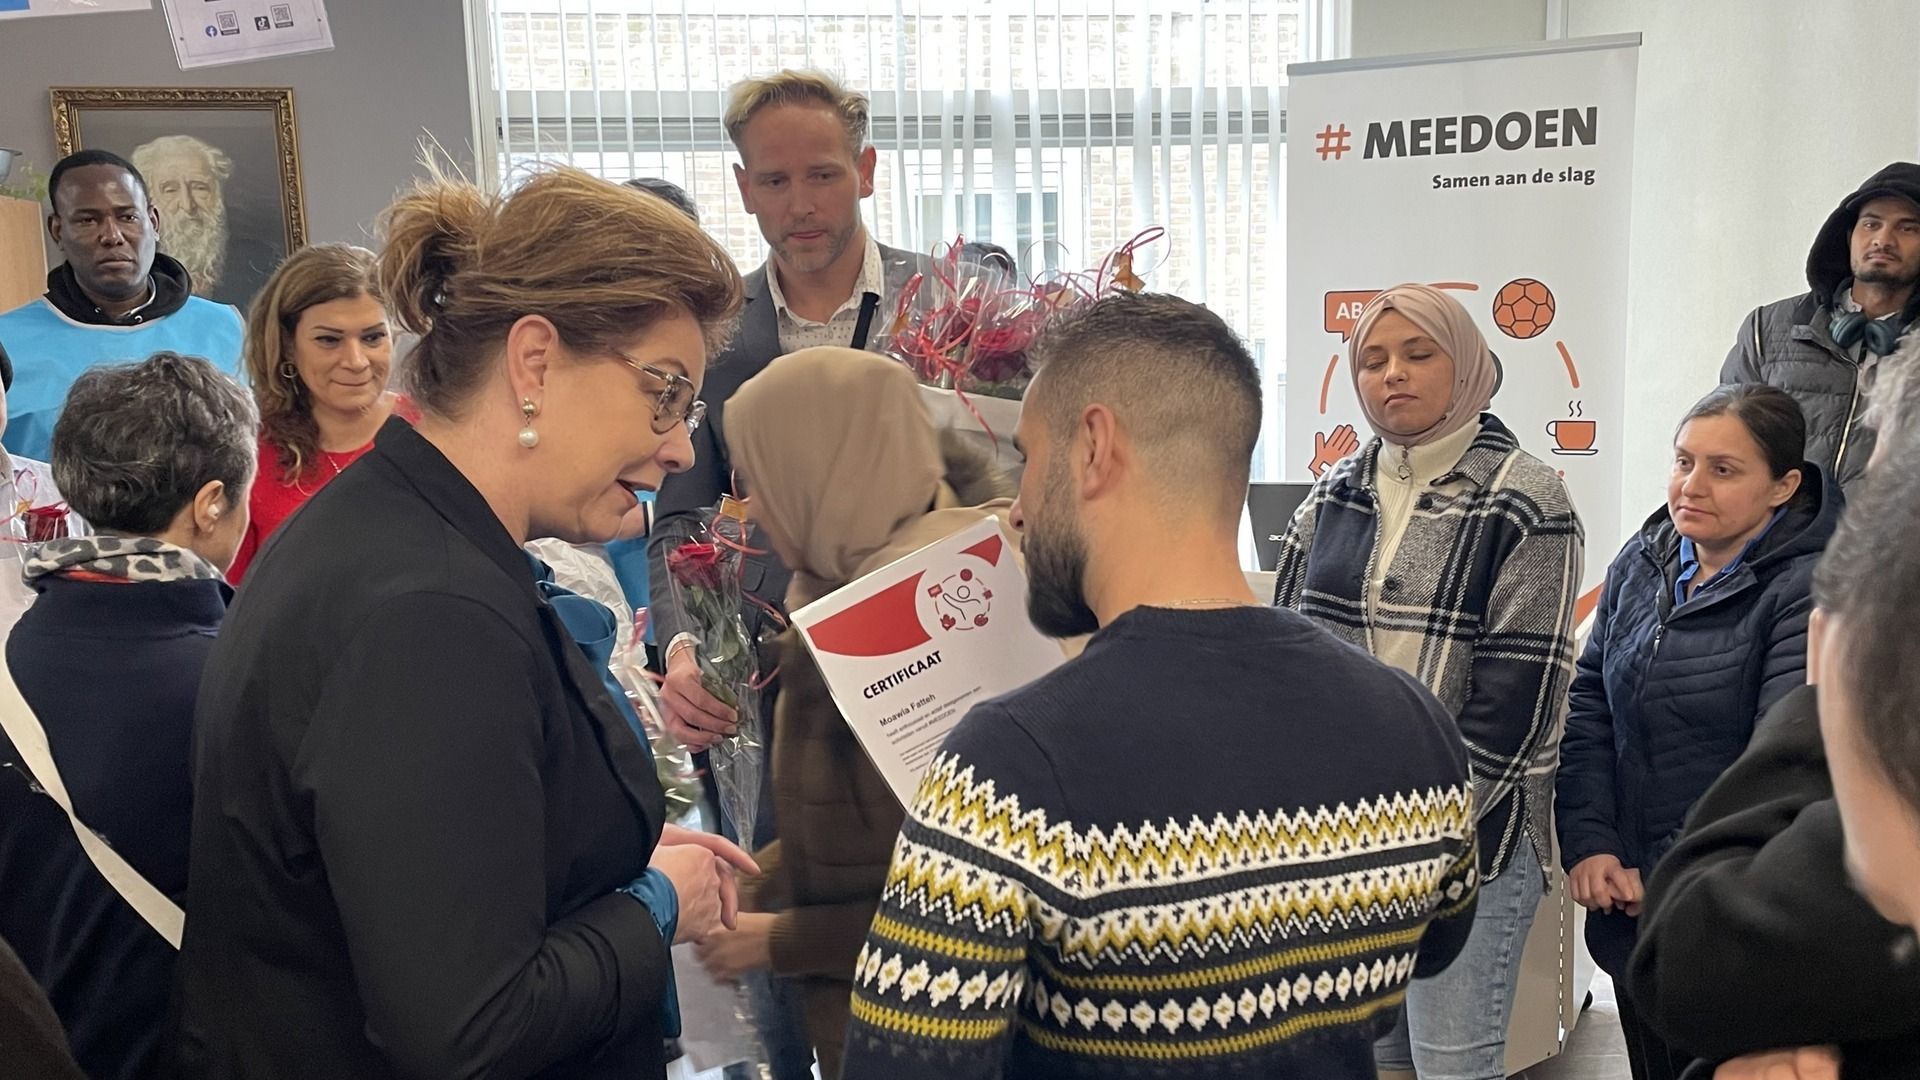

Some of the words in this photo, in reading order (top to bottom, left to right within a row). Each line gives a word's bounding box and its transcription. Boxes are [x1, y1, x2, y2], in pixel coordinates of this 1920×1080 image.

[1363, 106, 1598, 159] MEEDOEN
[1432, 174, 1490, 189] Samen
[1495, 173, 1527, 186] aan
[1532, 168, 1554, 183] de
[1558, 166, 1596, 185] slag
[1336, 302, 1364, 320] AB
[863, 650, 942, 700] CERTIFICAAT
[909, 693, 936, 711] Fatteh
